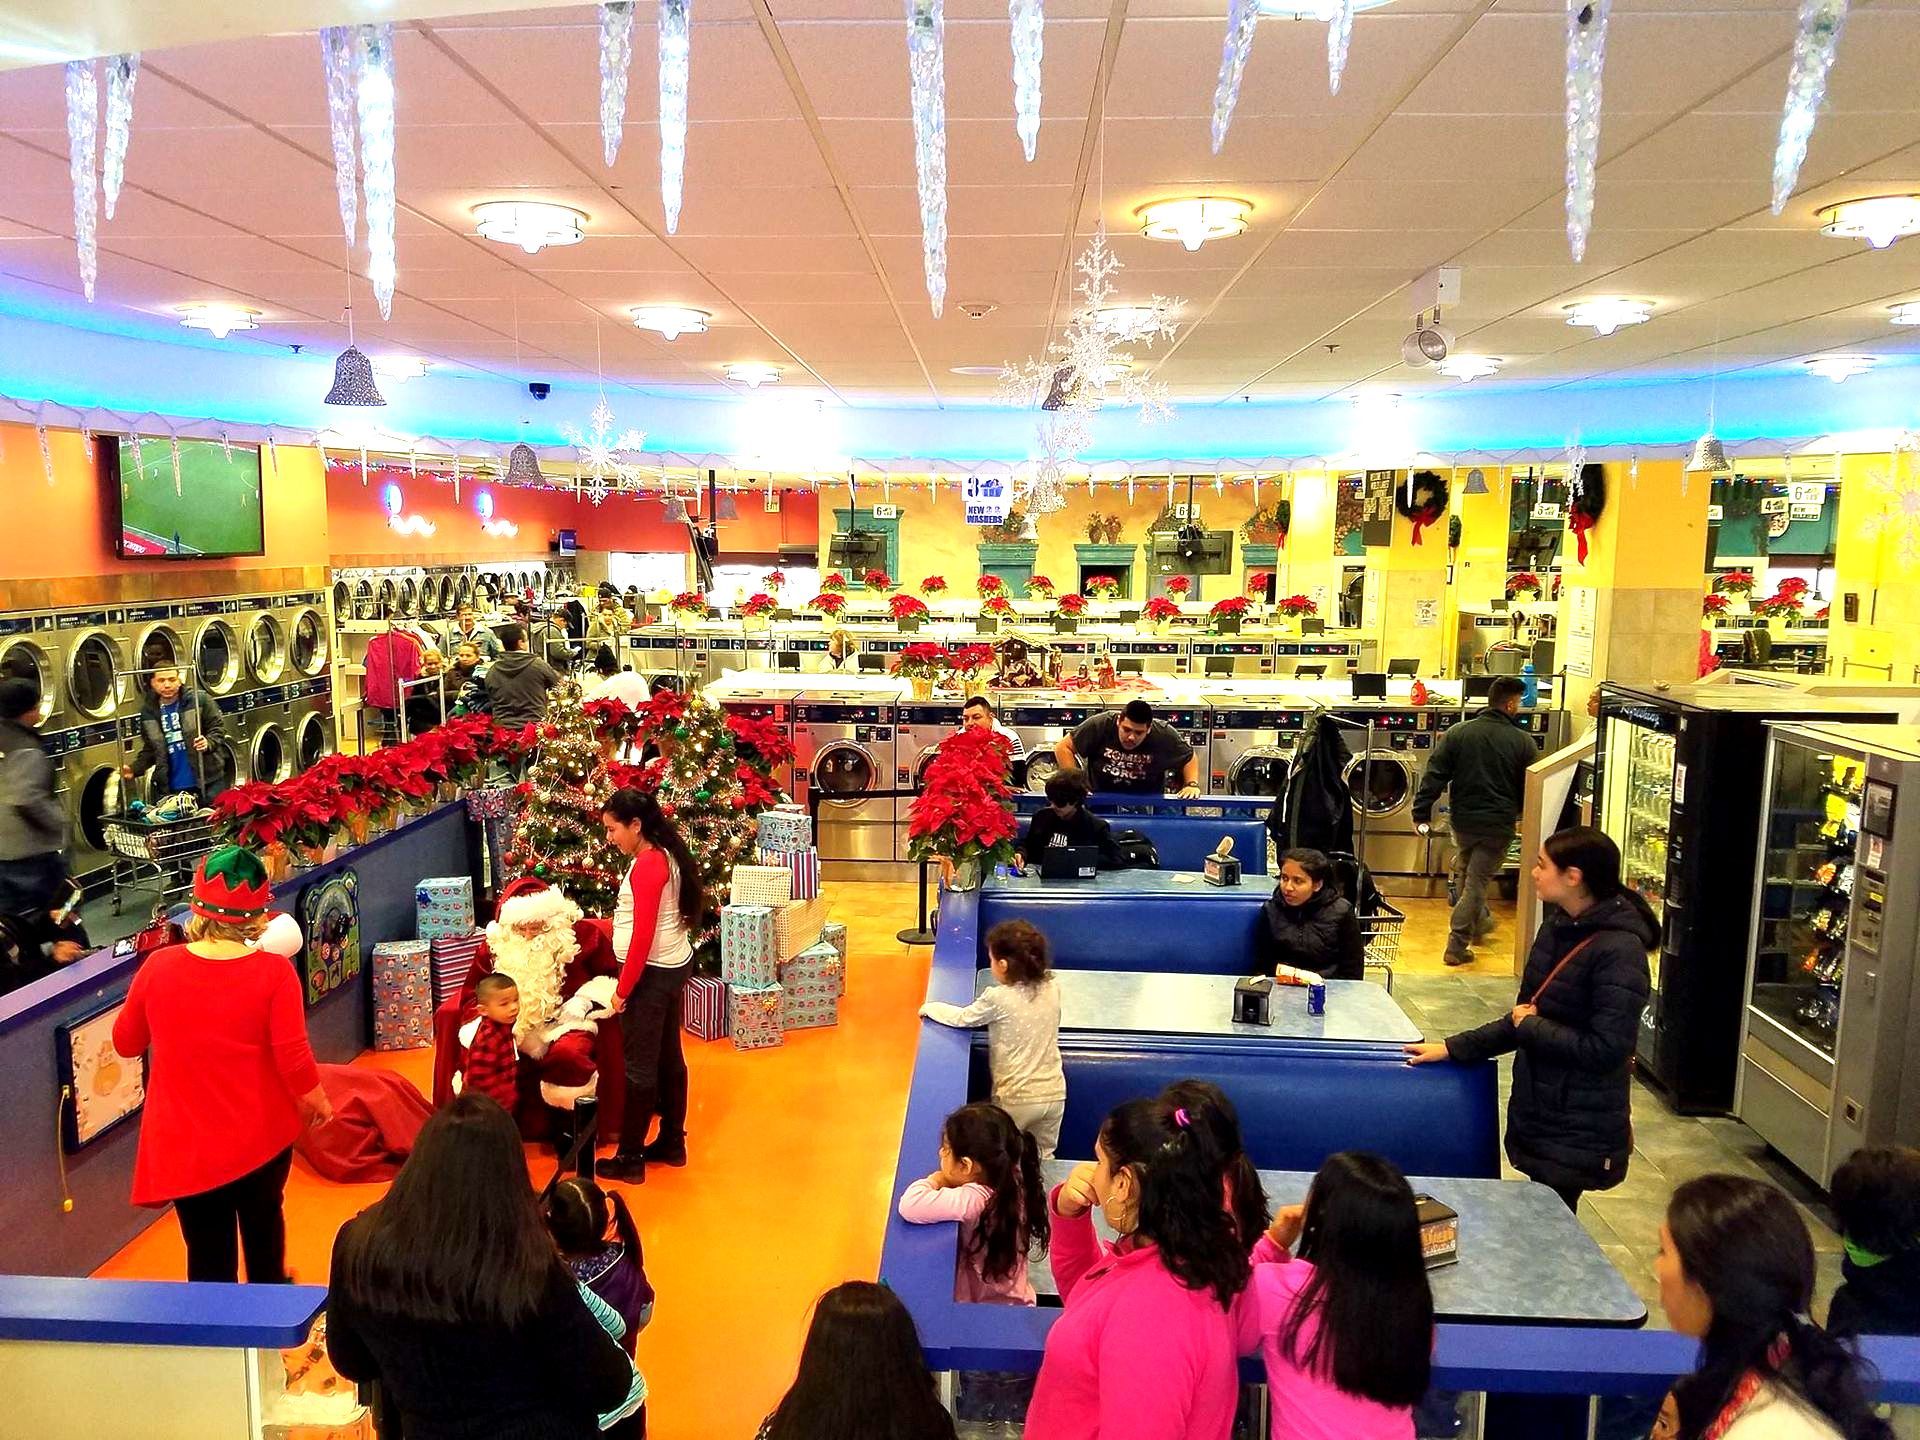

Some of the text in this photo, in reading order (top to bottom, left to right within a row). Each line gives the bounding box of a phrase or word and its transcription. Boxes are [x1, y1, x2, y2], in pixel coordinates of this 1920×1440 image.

[967, 477, 979, 498] 3
[1795, 486, 1803, 501] 6
[968, 505, 985, 515] NEW
[966, 515, 1003, 524] WASHERS
